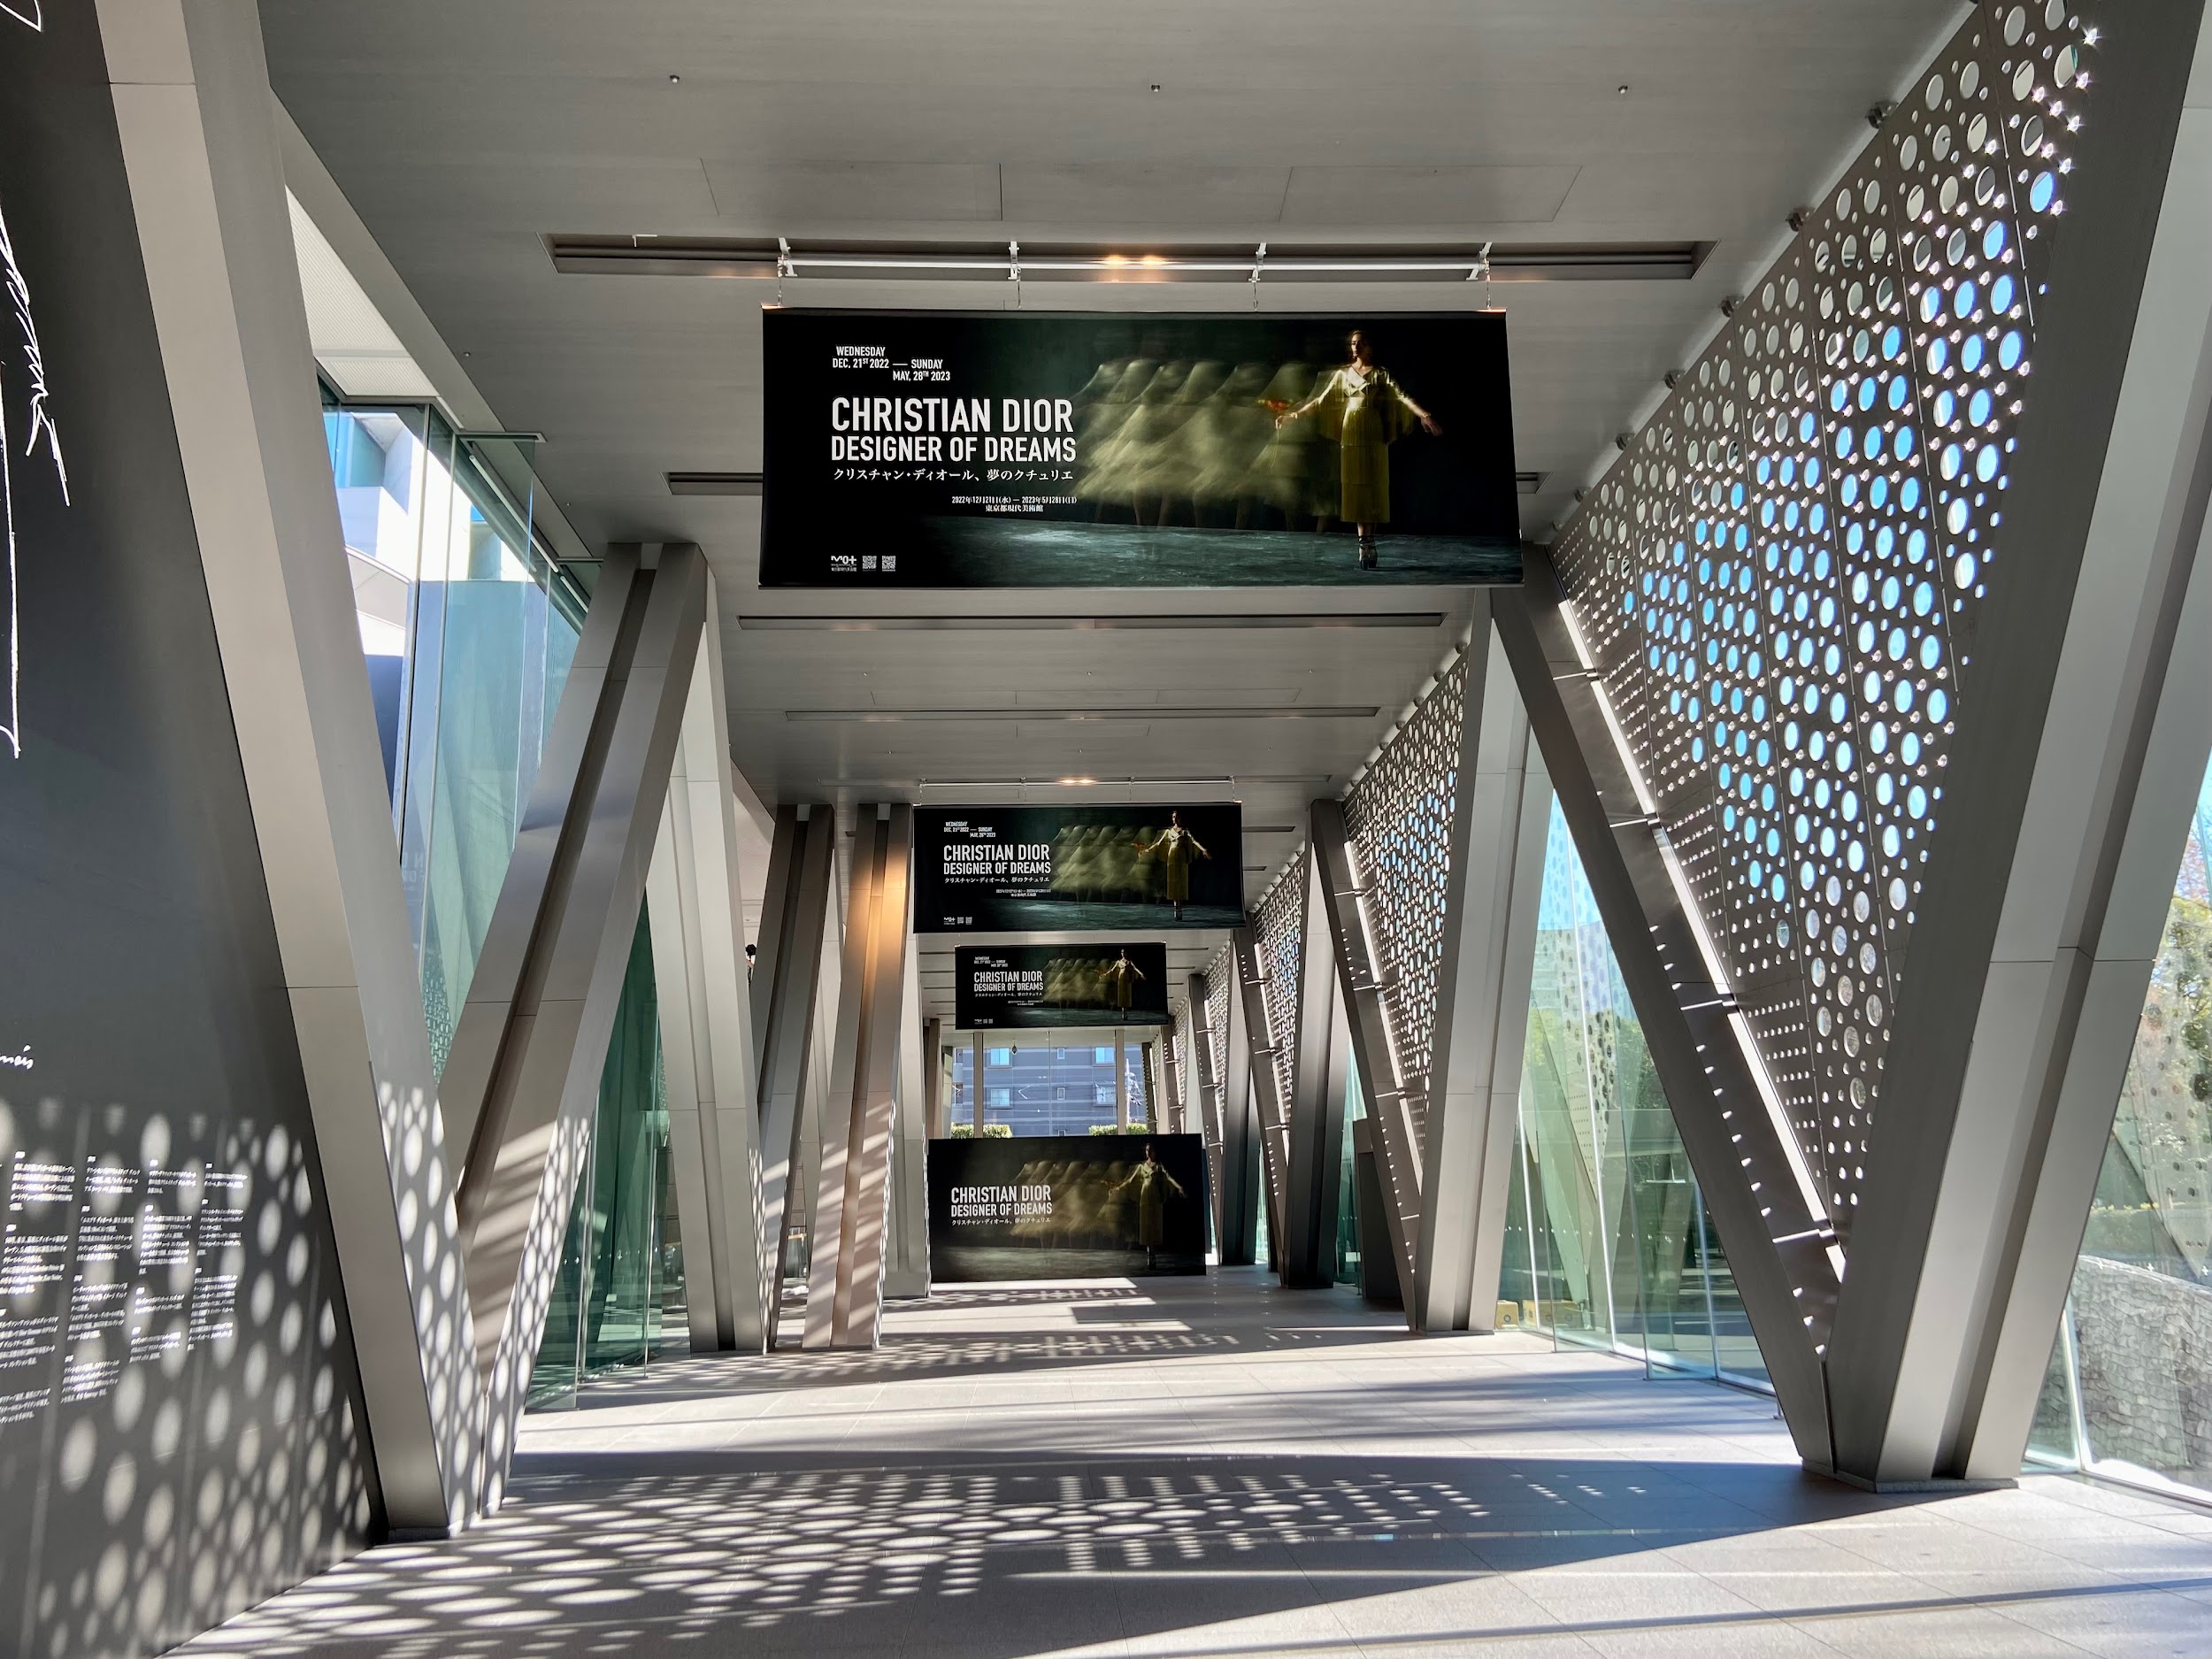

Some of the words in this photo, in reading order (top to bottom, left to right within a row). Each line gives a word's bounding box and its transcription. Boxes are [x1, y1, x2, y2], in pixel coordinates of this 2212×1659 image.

[836, 346, 886, 357] WEDNESDAY
[833, 358, 850, 369] DEC.
[853, 358, 869, 368] 21ST
[870, 358, 889, 368] 2022
[911, 358, 943, 369] SUNDAY
[913, 371, 929, 380] 28TH
[931, 371, 950, 380] 2023
[832, 397, 990, 432] CHRISTIAN
[1002, 398, 1073, 433] DIOR
[831, 435, 942, 461] DESIGNER
[949, 437, 977, 462] OF
[984, 437, 1077, 462] DREAMS
[833, 468, 1073, 481] クリスチャン・ディオール、夢のクチュリエ
[943, 844, 1014, 861] CHRISTIAN
[1018, 844, 1050, 861] DIOR
[943, 862, 992, 874] DESIGNER
[995, 862, 1008, 874] OF
[1010, 862, 1051, 874] DREAMS
[973, 971, 1019, 983] CHRISTIAN
[1021, 971, 1043, 982] DIOR
[973, 982, 1006, 992] DESIGNER
[1007, 982, 1016, 991] OF
[1017, 982, 1044, 991] DREAMS
[950, 1186, 1018, 1203] CHRISTIAN
[1021, 1184, 1051, 1202] DIOR
[950, 1203, 997, 1217] DESIGNER
[999, 1202, 1011, 1217] OF
[1013, 1202, 1053, 1216] DREAMS
